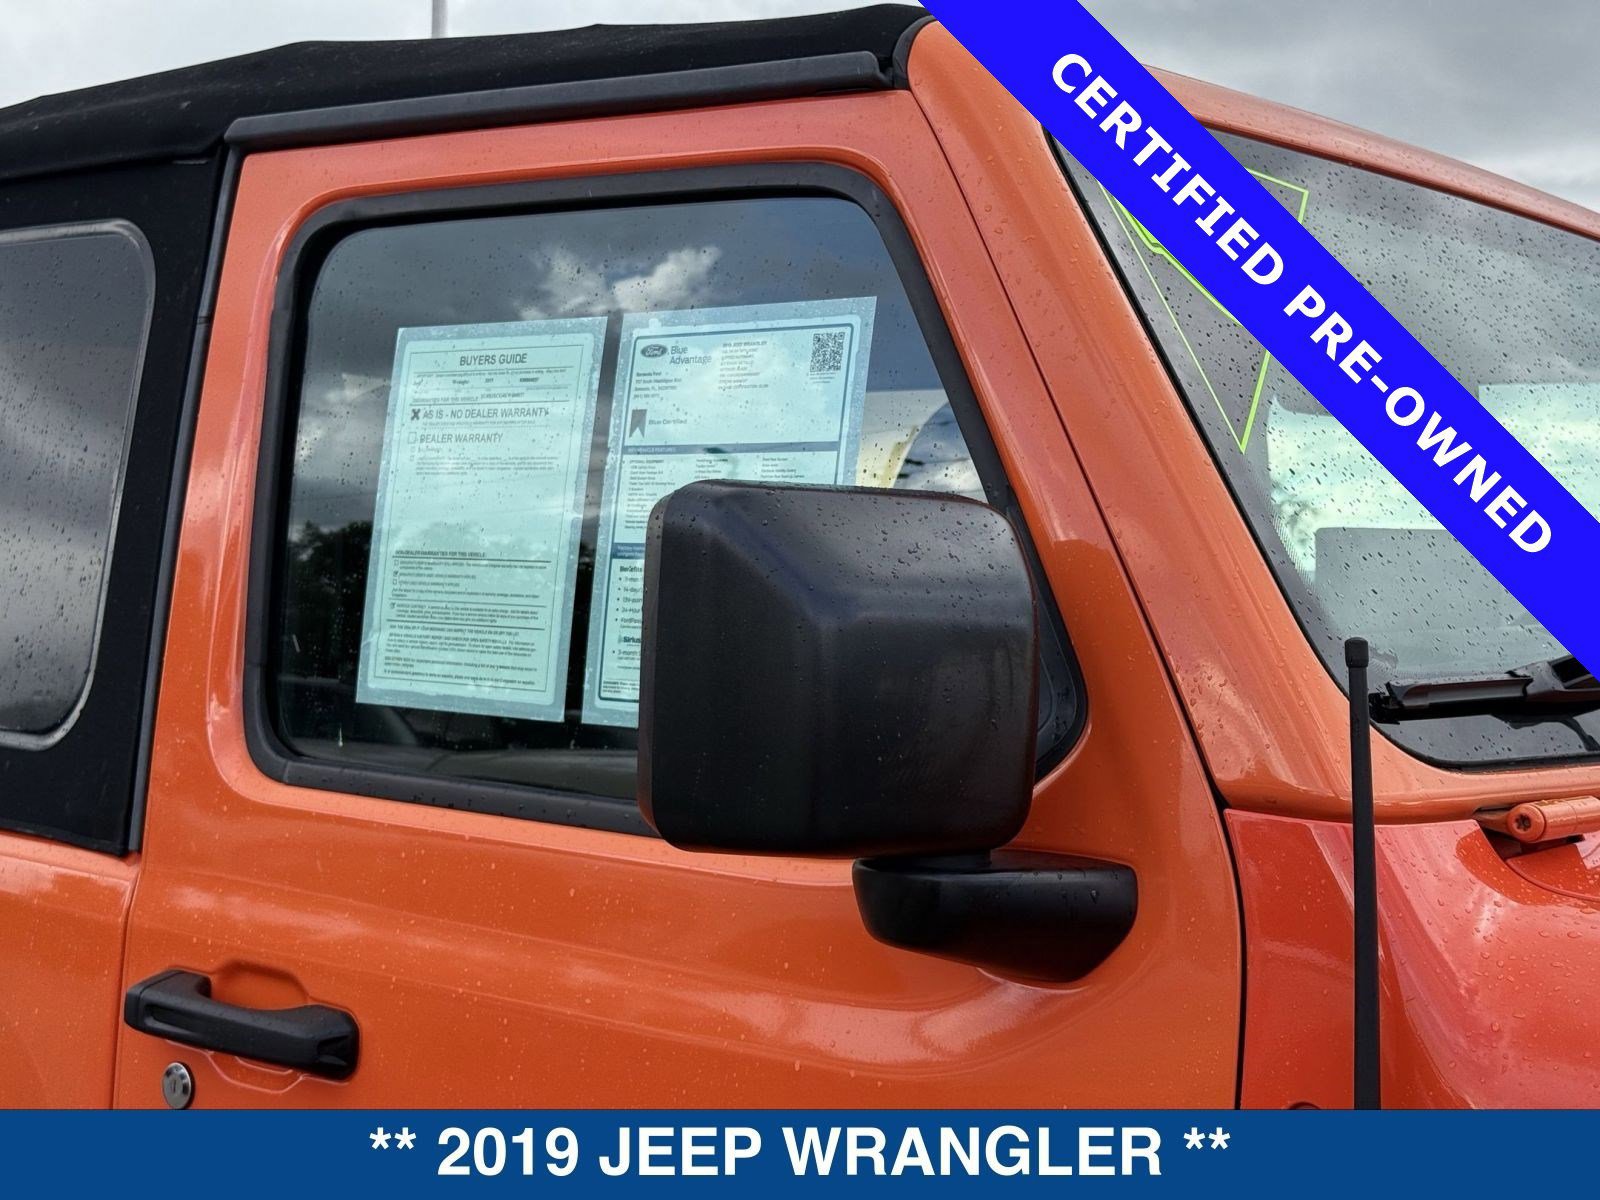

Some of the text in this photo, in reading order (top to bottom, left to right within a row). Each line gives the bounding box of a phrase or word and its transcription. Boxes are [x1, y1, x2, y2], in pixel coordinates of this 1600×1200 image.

[670, 345, 688, 355] Blue
[459, 353, 528, 366] BUYERS GUIDE
[669, 355, 712, 366] Advantage
[435, 409, 444, 420] IS
[450, 409, 464, 419] NO
[464, 408, 499, 419] DEALER
[500, 407, 549, 418] WARRANTY
[419, 432, 504, 444] DEALER WARRANTY
